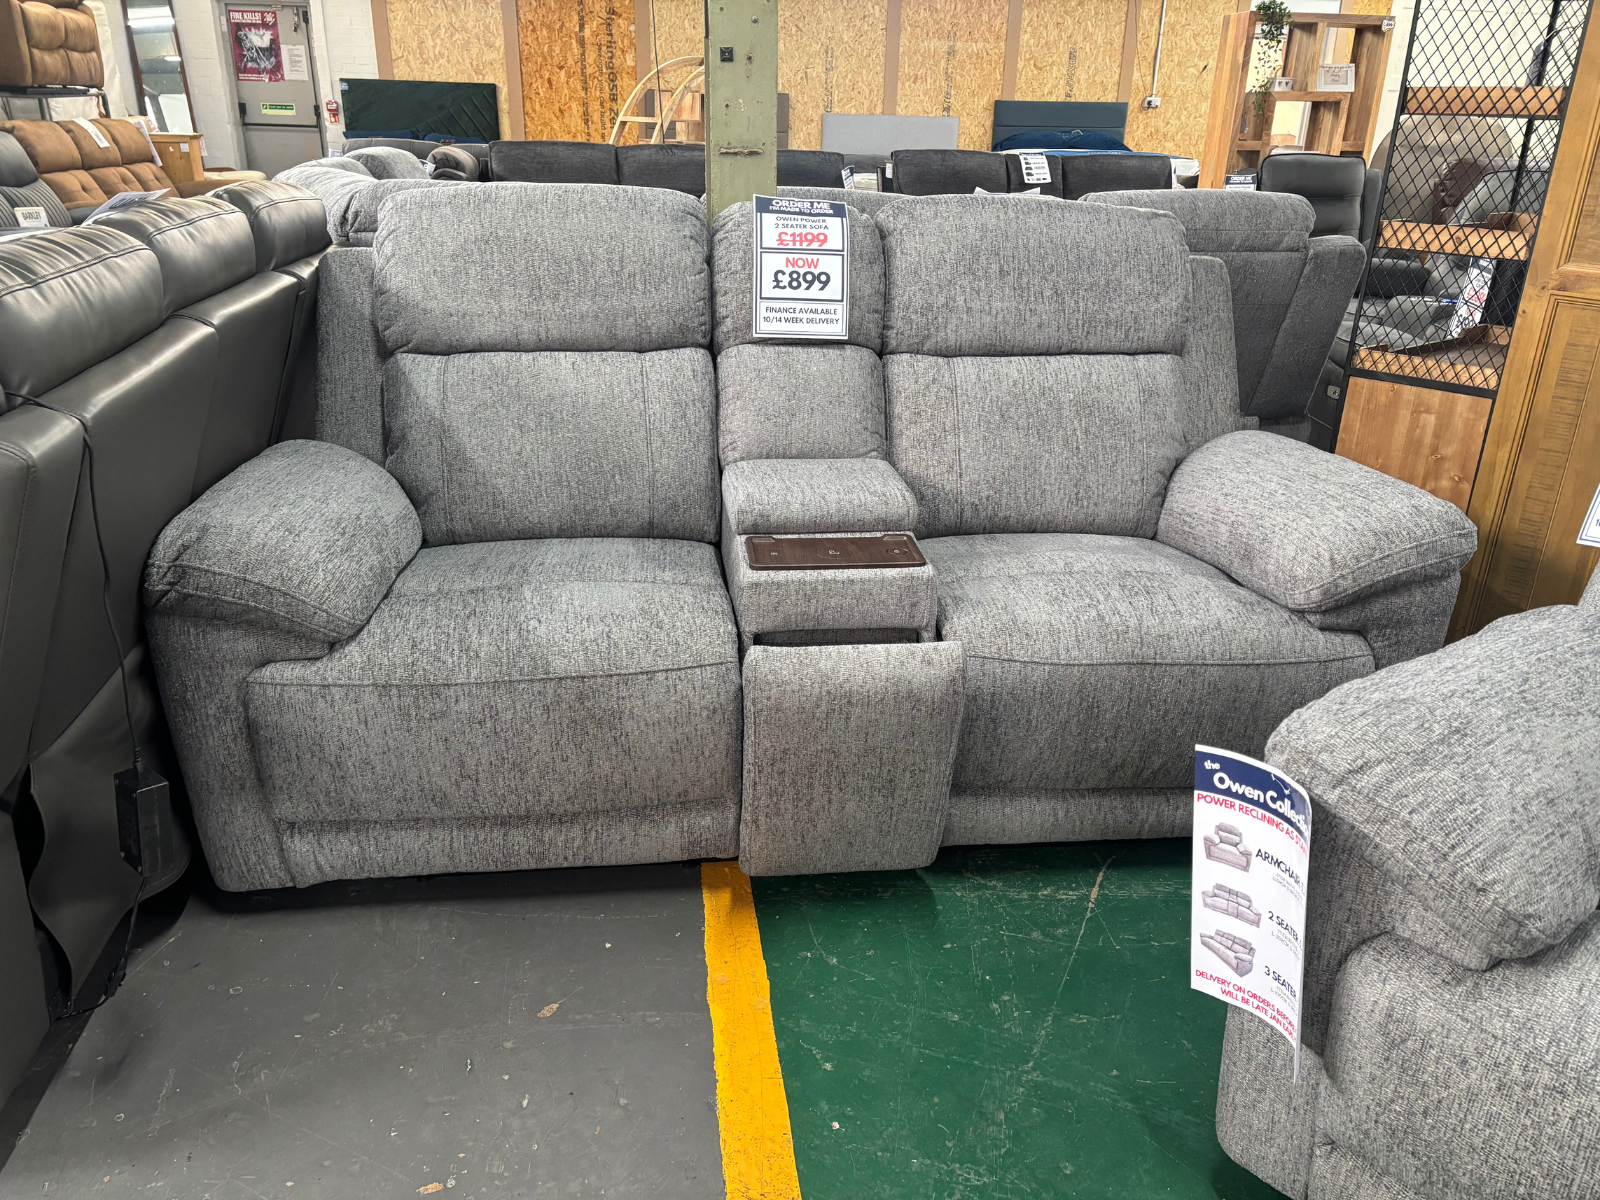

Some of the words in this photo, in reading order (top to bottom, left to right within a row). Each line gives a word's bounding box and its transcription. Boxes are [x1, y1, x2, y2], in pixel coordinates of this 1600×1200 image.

[243, 12, 262, 20] KILLS!
[772, 200, 812, 209] ORDER
[813, 202, 831, 210] ME
[776, 231, 828, 247] £1199
[785, 257, 820, 269] NOW
[772, 269, 831, 291] £899
[763, 316, 783, 324] 10/14
[806, 317, 840, 325] DELIVERY
[765, 306, 797, 314] FINANCE
[798, 307, 838, 315] AVAILABLE
[1204, 760, 1220, 770] the
[1197, 793, 1237, 812] POWER
[1238, 804, 1285, 832] RECLINING
[1285, 827, 1294, 840] AS
[1213, 772, 1265, 803] Owen
[1265, 790, 1309, 839] Collectio
[1255, 849, 1301, 888] ARMCHAIR
[1268, 911, 1275, 922] 2
[1275, 915, 1298, 943] SEATER
[1195, 969, 1231, 988] DELIVERY
[1232, 983, 1246, 995] ON
[1246, 989, 1275, 1012] ORDERS
[1264, 965, 1271, 977] 3
[1272, 970, 1297, 999] SEATER
[1220, 987, 1240, 1002] WILL
[1241, 996, 1251, 1007] BE
[1251, 1000, 1269, 1017] LATE
[1269, 1011, 1282, 1027] JAN
